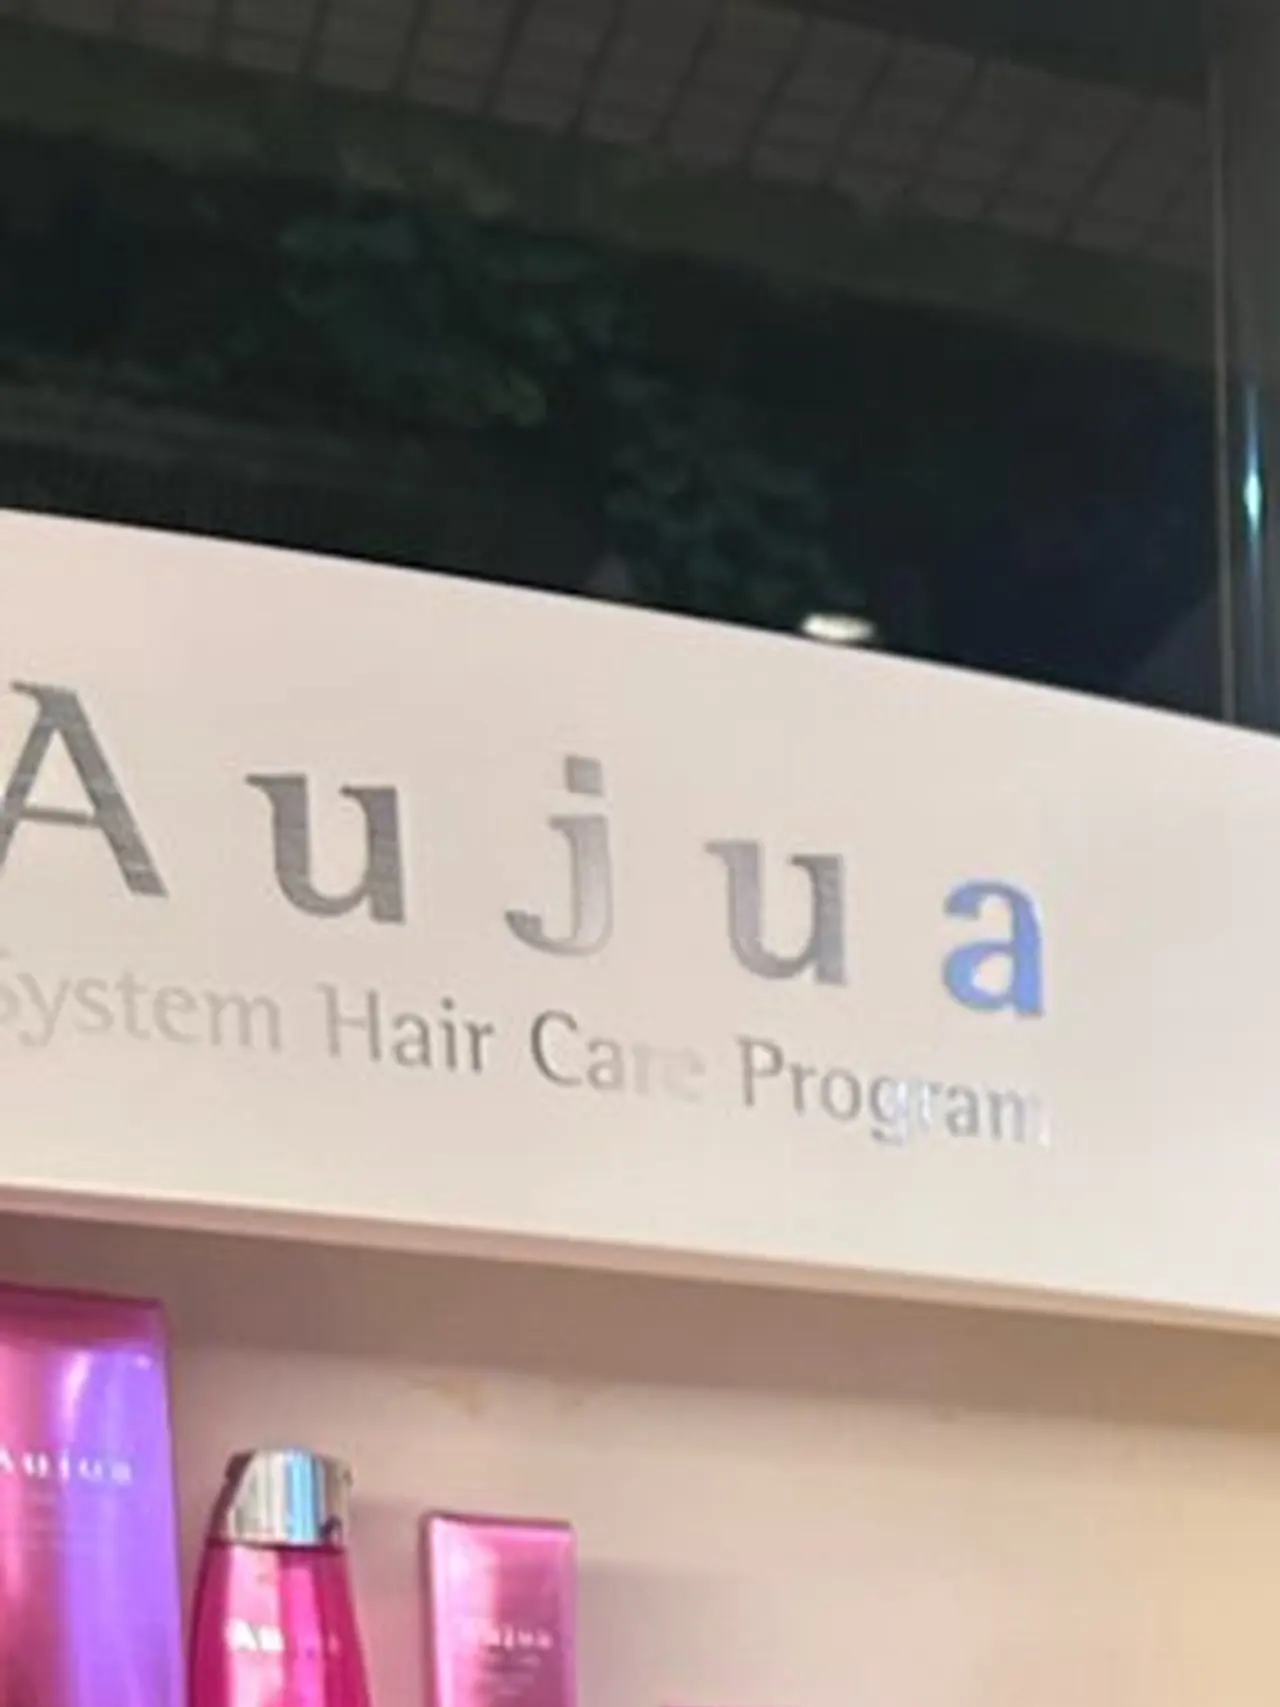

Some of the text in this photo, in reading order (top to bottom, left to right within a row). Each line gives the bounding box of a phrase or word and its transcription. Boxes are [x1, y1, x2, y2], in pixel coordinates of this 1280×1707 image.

[0, 680, 1046, 1018] Aujua
[313, 980, 495, 1074] Hair
[530, 1010, 706, 1103] Care
[734, 1034, 1053, 1146] Program
